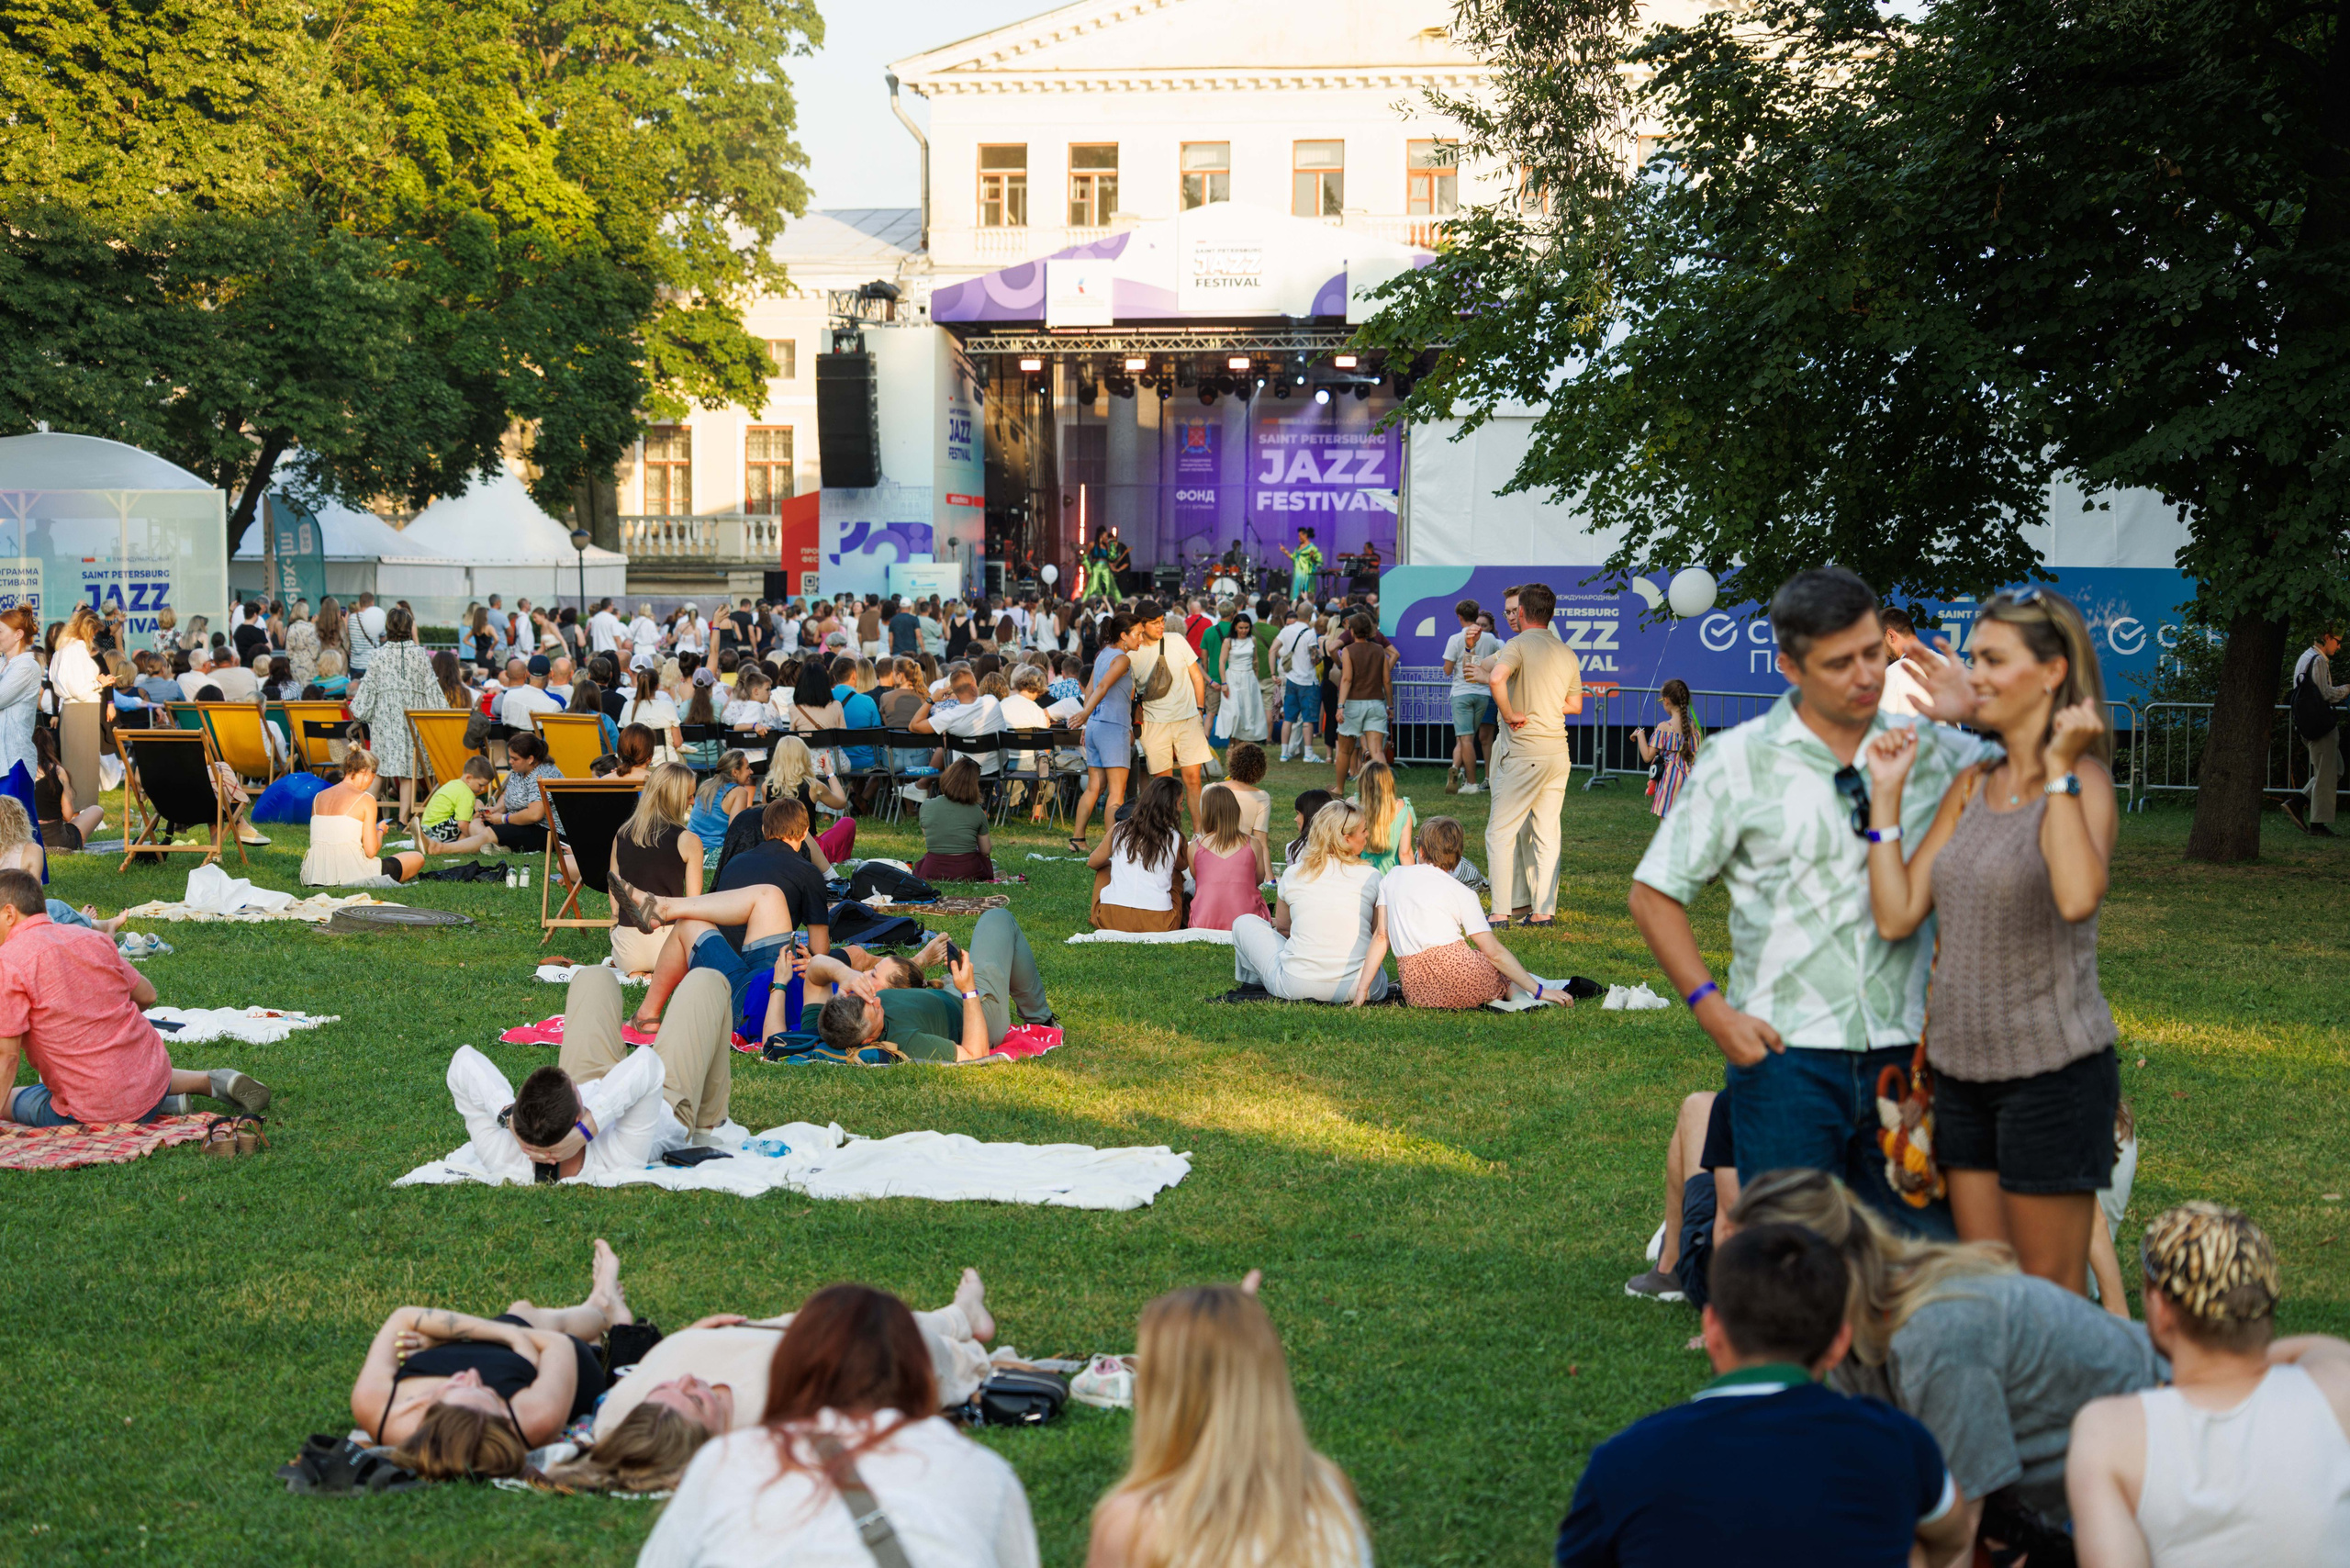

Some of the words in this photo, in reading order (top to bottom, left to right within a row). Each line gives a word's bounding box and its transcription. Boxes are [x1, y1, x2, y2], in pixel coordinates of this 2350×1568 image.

[1193, 254, 1262, 275] JAZZ
[1195, 277, 1261, 287] FESTIVAL
[948, 419, 971, 444] JAZZ
[1259, 433, 1298, 444] SAINT
[1301, 433, 1386, 444] PETERSBURG
[1258, 449, 1385, 485] JAZZ
[1176, 489, 1215, 503] ФОНД
[0, 567, 39, 577] ГРАММА
[82, 570, 109, 579] SAINT
[111, 569, 170, 578] PETERSBURG
[1553, 608, 1619, 617] ETERSBURG
[1937, 610, 1973, 619] SAINT
